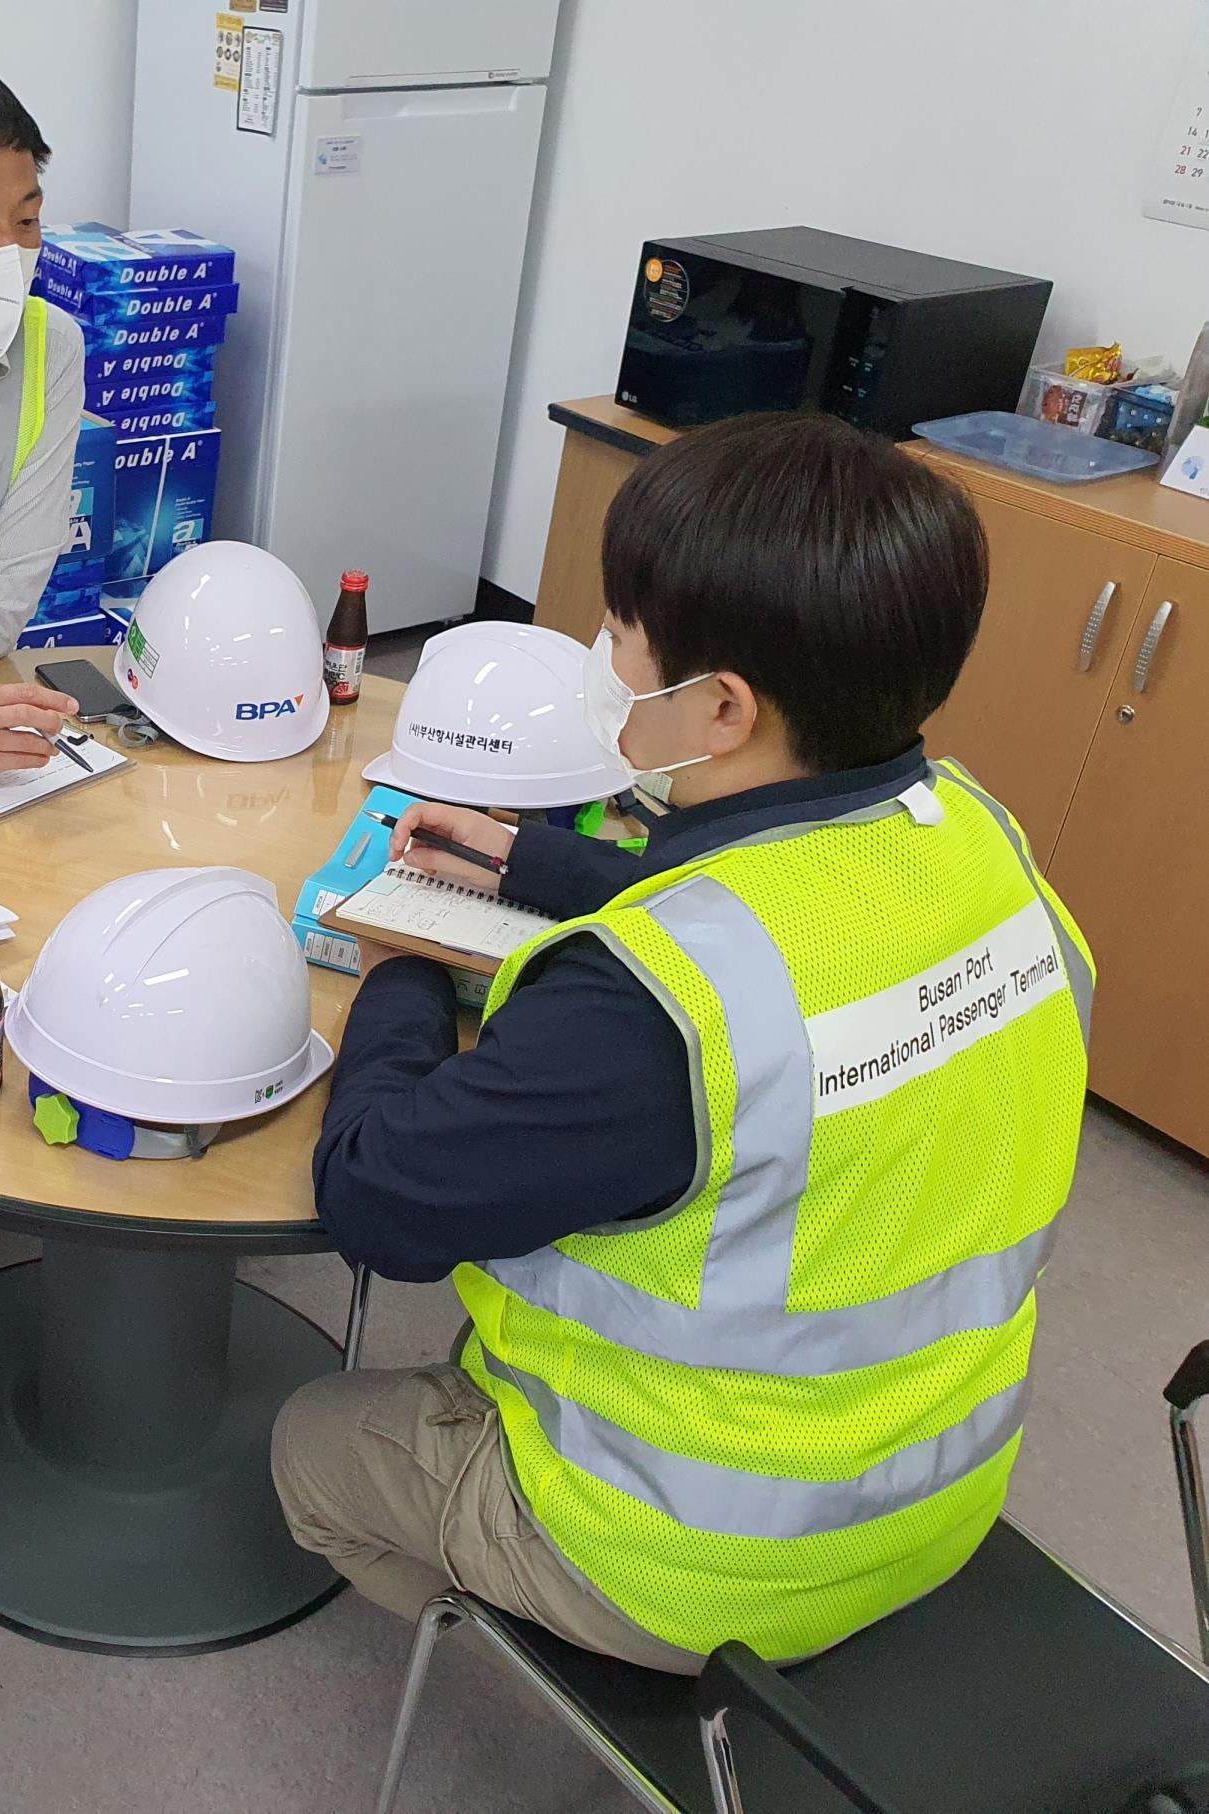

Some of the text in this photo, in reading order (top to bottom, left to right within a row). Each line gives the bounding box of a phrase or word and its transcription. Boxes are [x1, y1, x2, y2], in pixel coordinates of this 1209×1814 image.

[1187, 126, 1198, 137] 14
[1179, 145, 1209, 160] 21 22
[1174, 164, 1204, 178] 28 29
[42, 246, 66, 266] Double
[120, 265, 188, 284] Double
[47, 278, 72, 298] Double
[126, 297, 192, 316] Double
[113, 327, 180, 345] Double
[123, 353, 187, 371] Double
[120, 382, 184, 402] Double
[121, 412, 186, 430] Double
[114, 446, 175, 470] ouble
[236, 699, 296, 721] BPA
[918, 947, 994, 1013] Busan Port
[819, 946, 1060, 1097] International Passenger Terminal
